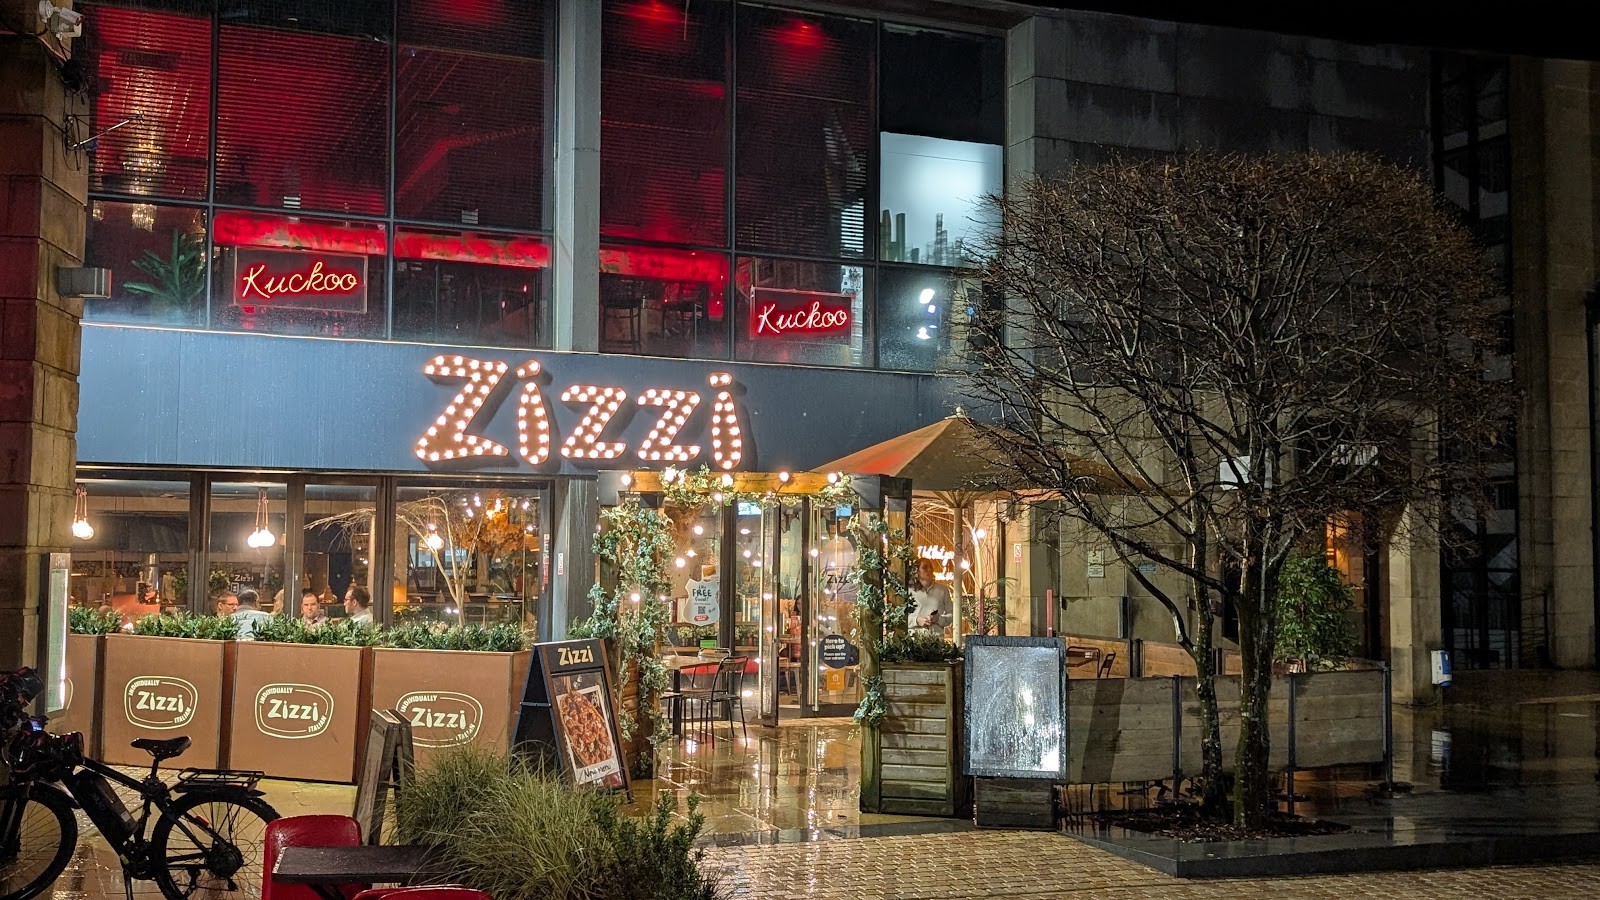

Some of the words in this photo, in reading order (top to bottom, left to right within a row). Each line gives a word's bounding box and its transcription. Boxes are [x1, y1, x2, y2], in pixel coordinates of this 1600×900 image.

[242, 261, 358, 298] Kuckoo
[757, 301, 848, 334] Kuckoo
[414, 354, 742, 470] Zizzi
[234, 574, 254, 582] Zizzi
[692, 588, 712, 597] FREE
[557, 646, 594, 667] Zizzi
[128, 680, 161, 696] INDIVIDUALLY
[259, 687, 293, 704] INDIVIDUALLY
[136, 691, 184, 713] Zizzi
[267, 699, 319, 722] Zizzi
[400, 695, 438, 713] INDIVIDUALLY
[174, 706, 192, 723] ITALIAN
[308, 715, 327, 733] ITALIAN
[411, 707, 467, 730] Zizzi
